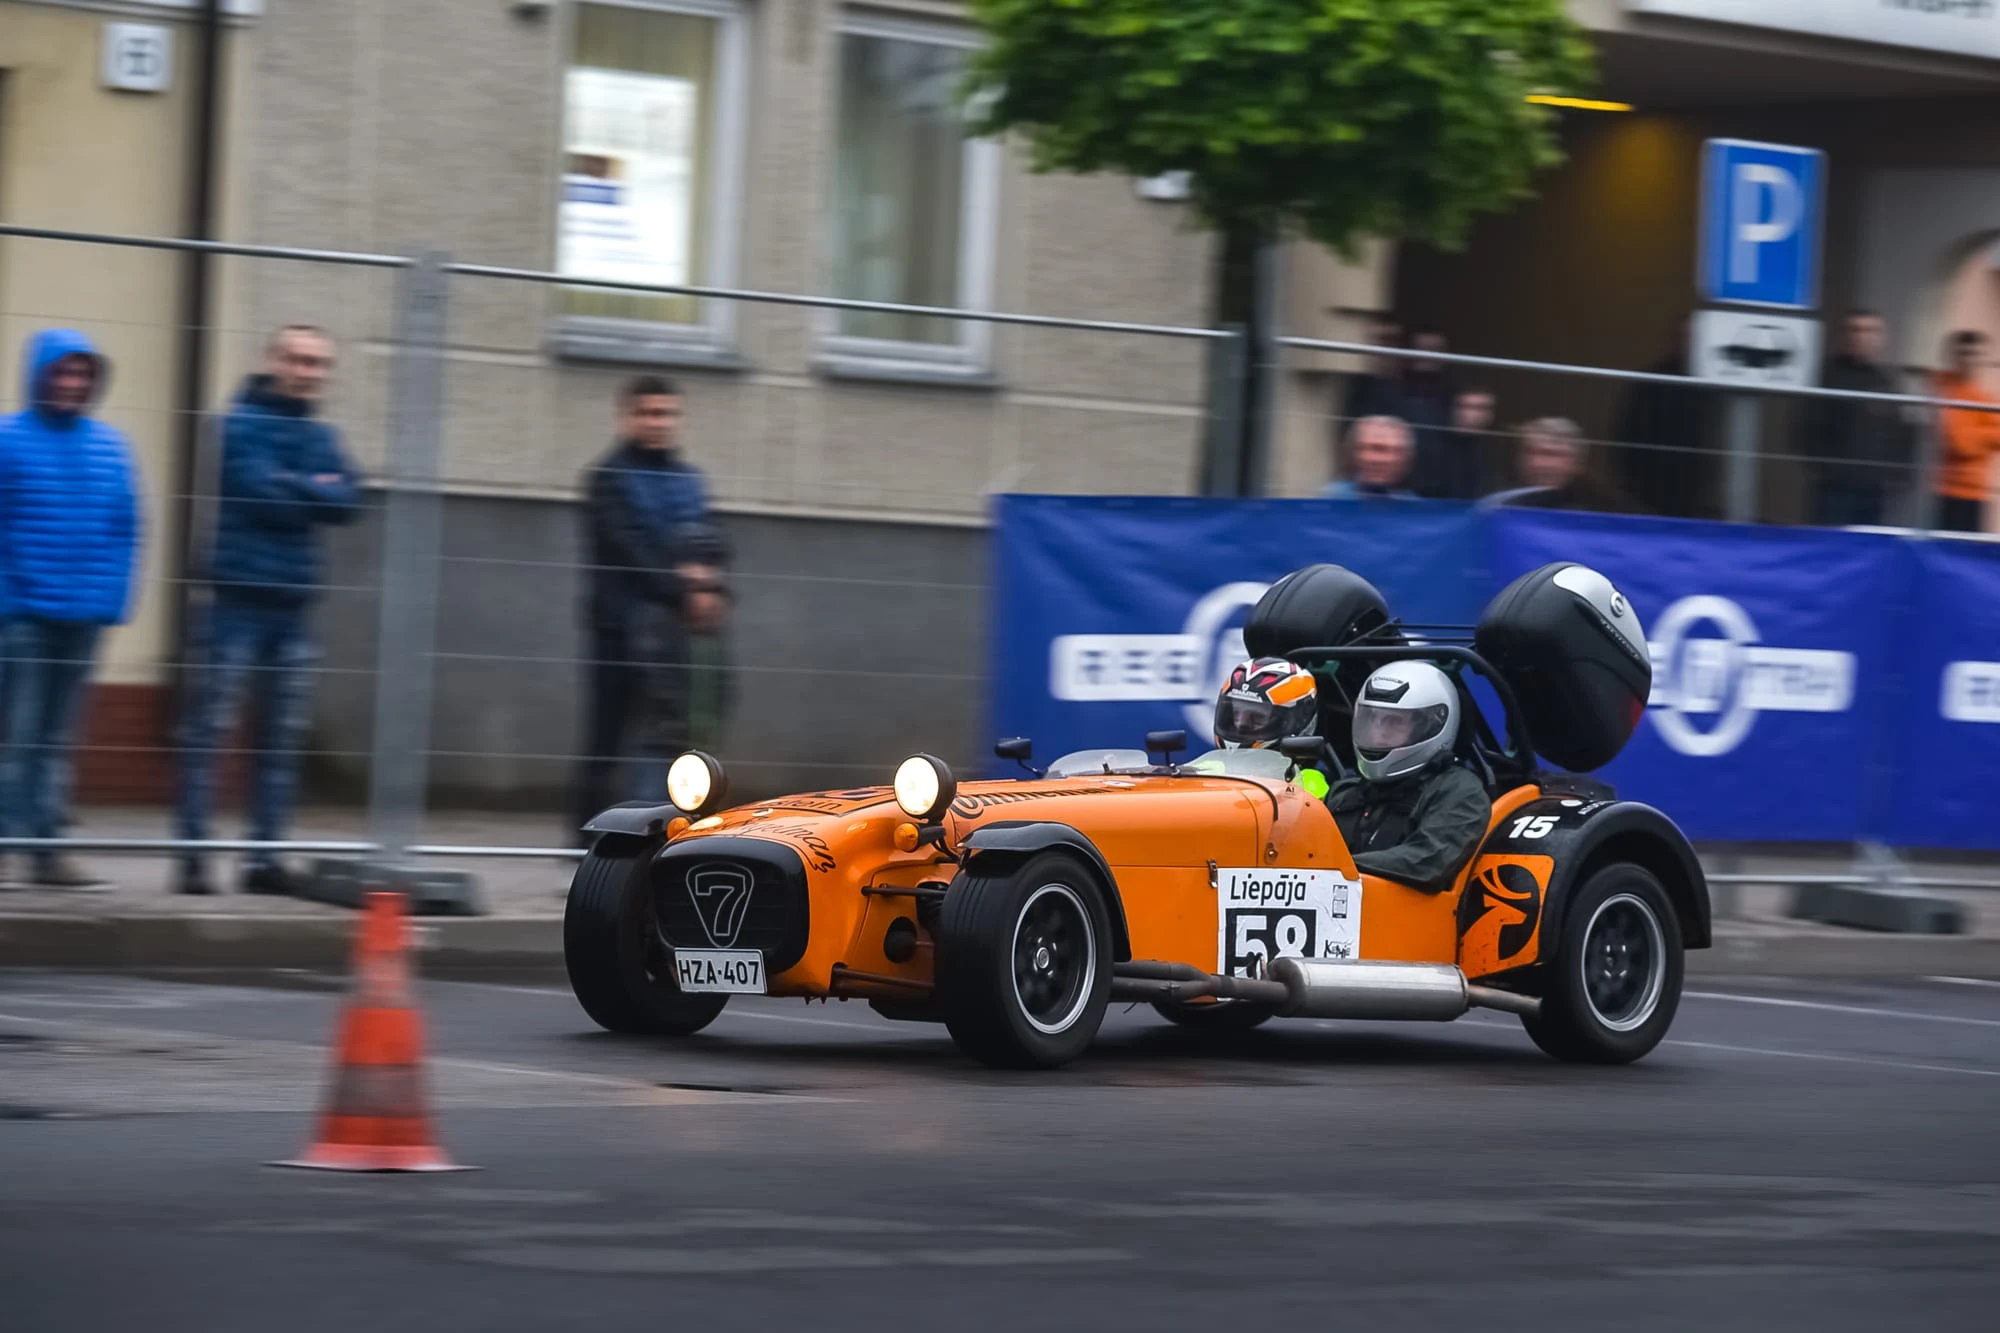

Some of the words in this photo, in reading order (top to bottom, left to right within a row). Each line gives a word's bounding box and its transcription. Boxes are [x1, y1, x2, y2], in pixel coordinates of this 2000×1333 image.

[1727, 162, 1804, 284] P
[1508, 816, 1560, 838] 15
[695, 871, 746, 937] 7
[1230, 873, 1307, 907] Liepāja
[1234, 914, 1308, 979] 58
[678, 959, 760, 985] HZA-407
